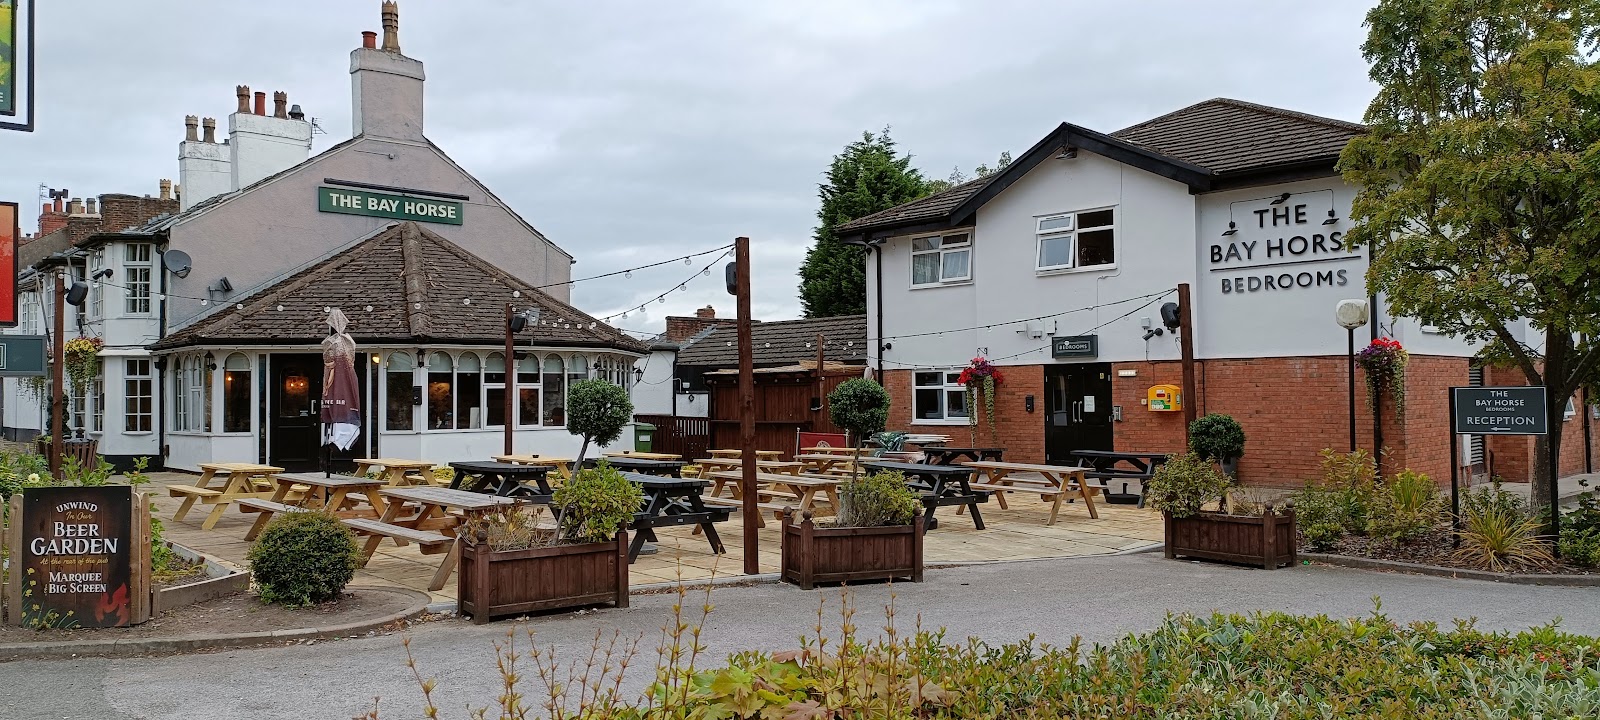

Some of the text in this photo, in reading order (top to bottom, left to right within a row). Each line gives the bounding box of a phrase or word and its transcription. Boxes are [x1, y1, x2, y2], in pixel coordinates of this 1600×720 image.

[329, 193, 457, 218] THE BAY HORSE
[1253, 204, 1307, 228] THE
[1210, 240, 1257, 263] BAY
[1221, 269, 1348, 294] BEDROOMS
[1466, 416, 1535, 425] RECEPTION
[56, 502, 98, 512] UNWIND
[66, 511, 93, 520] In Our
[54, 521, 99, 537] BEER
[31, 538, 118, 555] GARDEN
[40, 557, 49, 565] At
[50, 557, 61, 565] the
[77, 557, 85, 566] of
[96, 557, 109, 565] pub
[49, 571, 102, 583] MARQUEE
[49, 583, 67, 594] BIG
[69, 582, 107, 594] SCREEN
